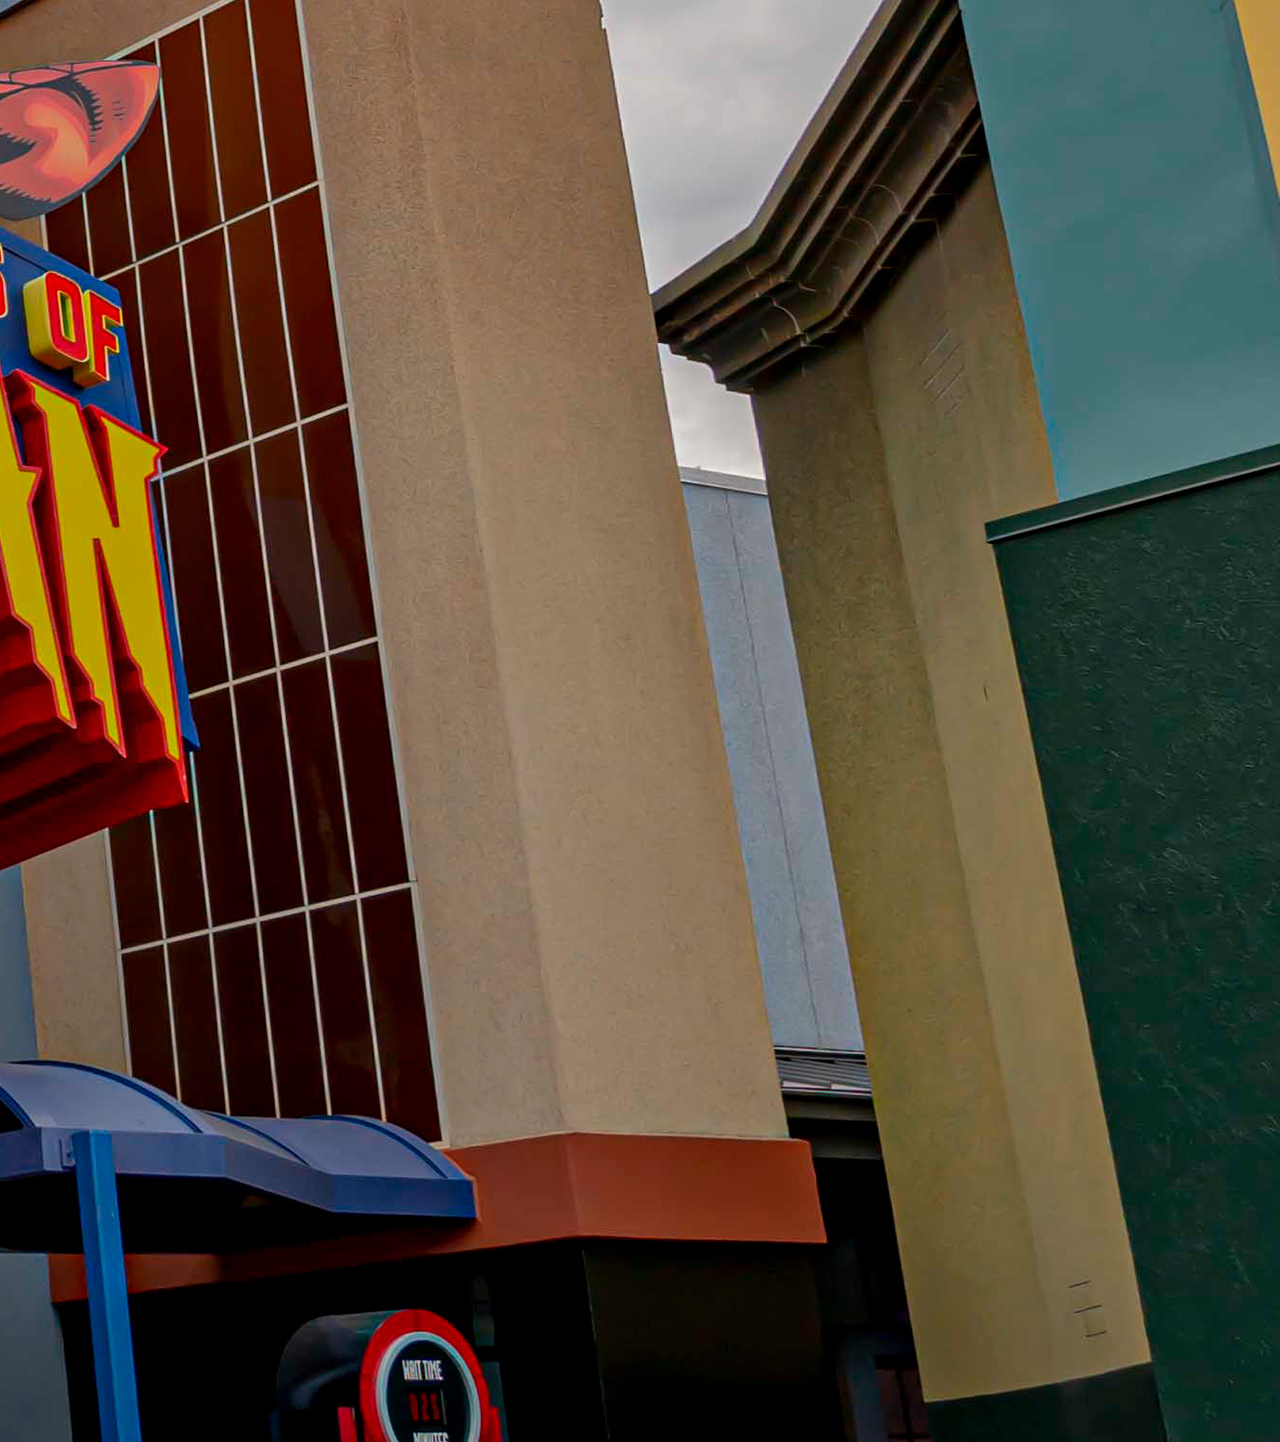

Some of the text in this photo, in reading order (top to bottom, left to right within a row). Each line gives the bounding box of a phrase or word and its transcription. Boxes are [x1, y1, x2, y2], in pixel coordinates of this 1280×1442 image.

[25, 268, 125, 387] OF
[402, 1359, 444, 1381] WAIT TIME
